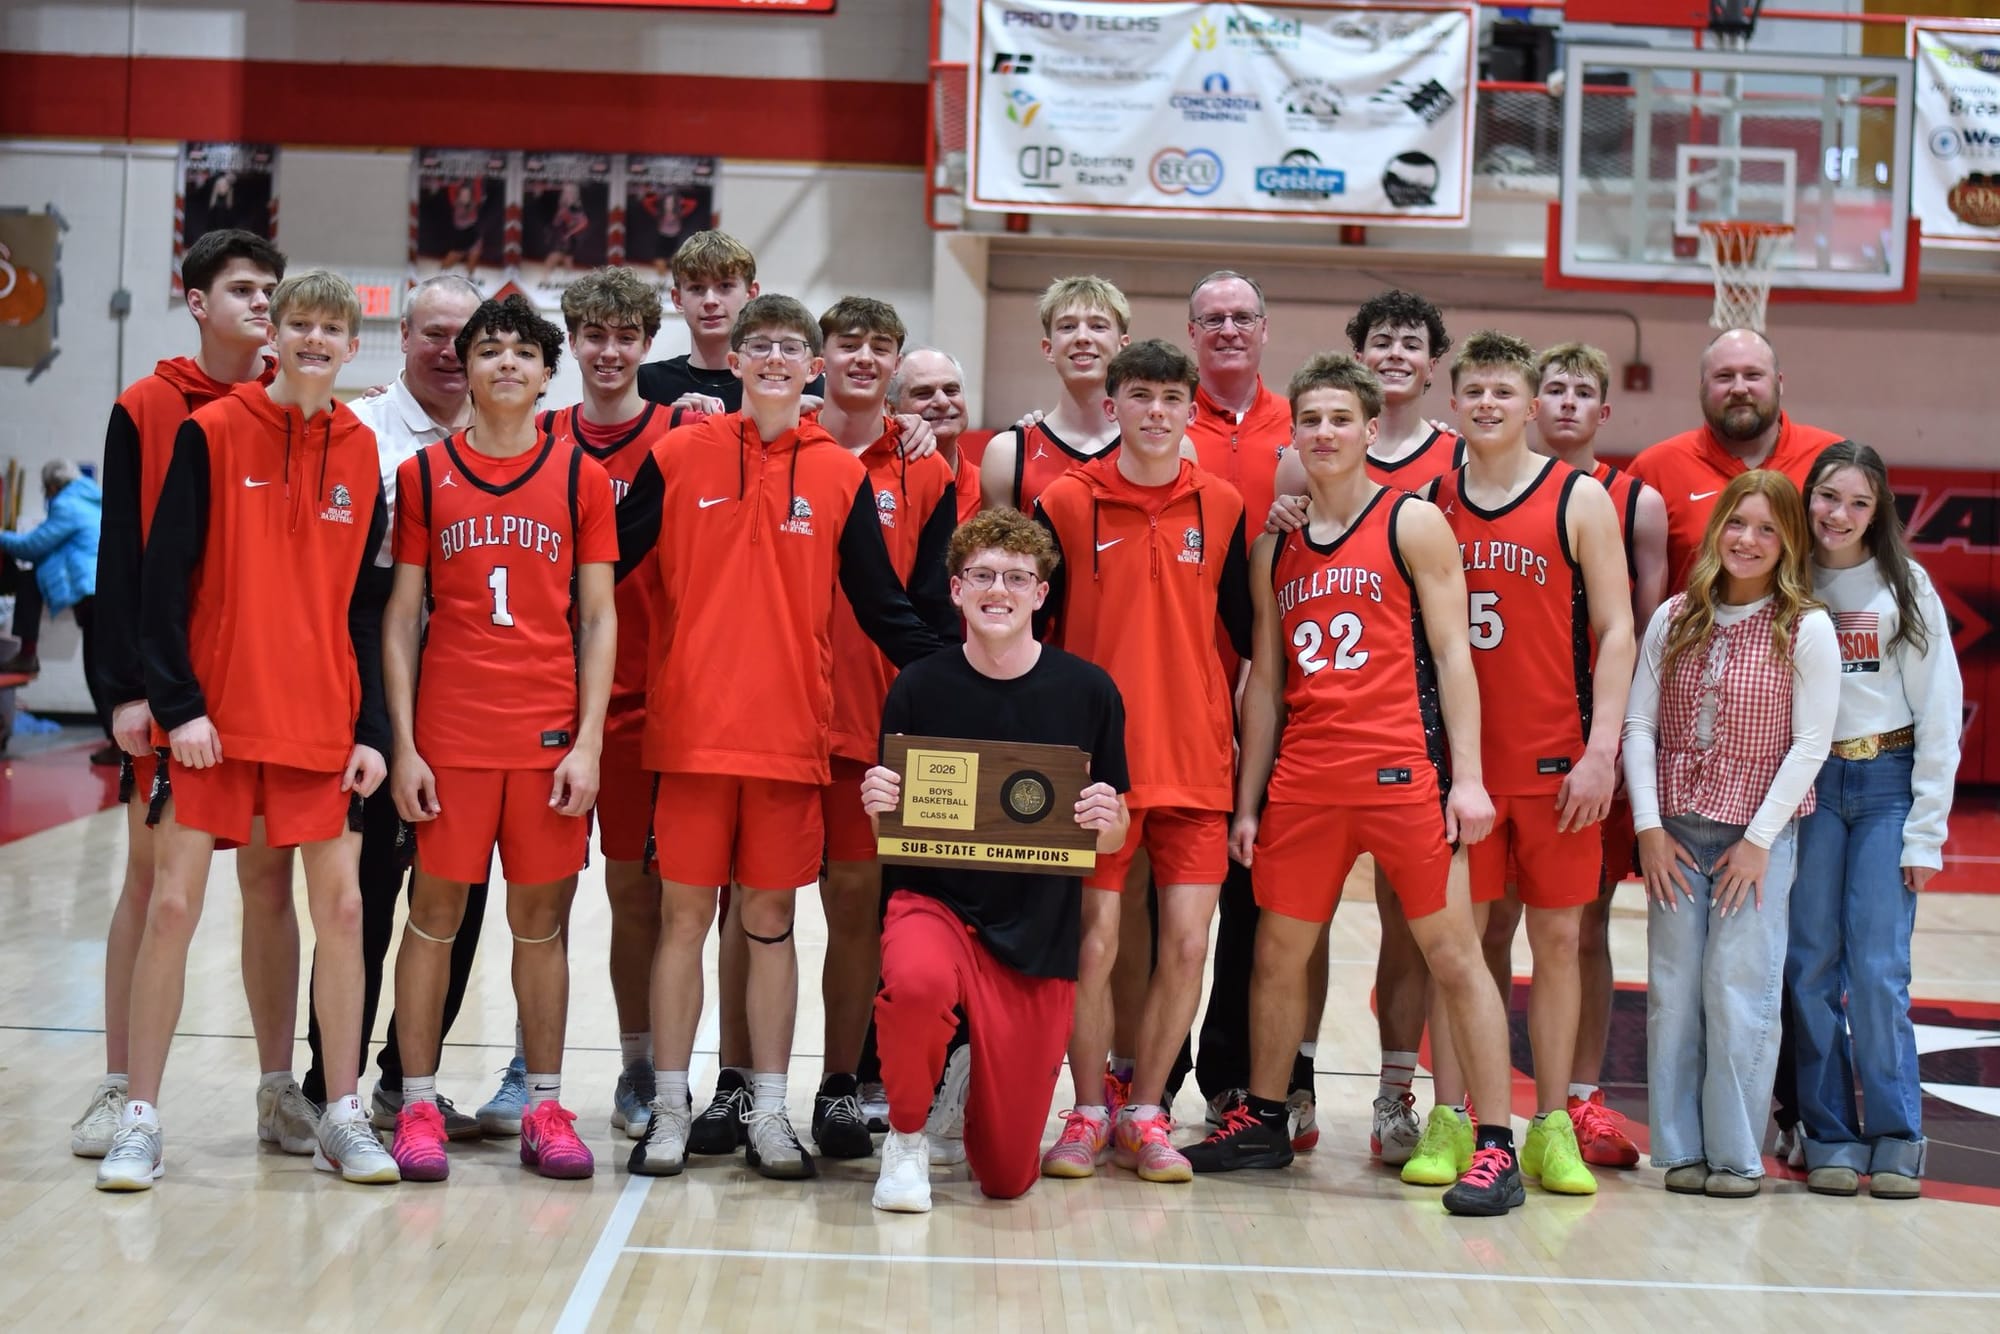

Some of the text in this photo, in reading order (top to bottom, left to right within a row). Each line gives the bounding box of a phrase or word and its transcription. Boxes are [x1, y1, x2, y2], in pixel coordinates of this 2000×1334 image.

[1003, 11, 1160, 32] PRO TECHS
[1226, 15, 1301, 37] Kindel
[1169, 95, 1262, 111] CONCORDIA
[1951, 96, 2000, 115] Brea
[1183, 110, 1247, 123] TERMINAL
[1962, 129, 2000, 147] We
[1070, 152, 1135, 171] Doering
[1158, 158, 1216, 184] RFCU
[1077, 172, 1126, 186] Ranch
[1259, 170, 1340, 193] Geisler
[440, 514, 562, 564] BULLPUPS
[1459, 540, 1548, 586] LLPUPS
[488, 565, 515, 627] 1
[1276, 567, 1383, 621] BULLPUPS
[1292, 611, 1370, 678] 22
[929, 763, 956, 775] 2026
[912, 795, 969, 807] BASKETBALL
[929, 787, 953, 797] BOYS
[920, 811, 959, 821] CLASS 4A
[901, 841, 1070, 863] SUB-STATE CHAMPIONS
